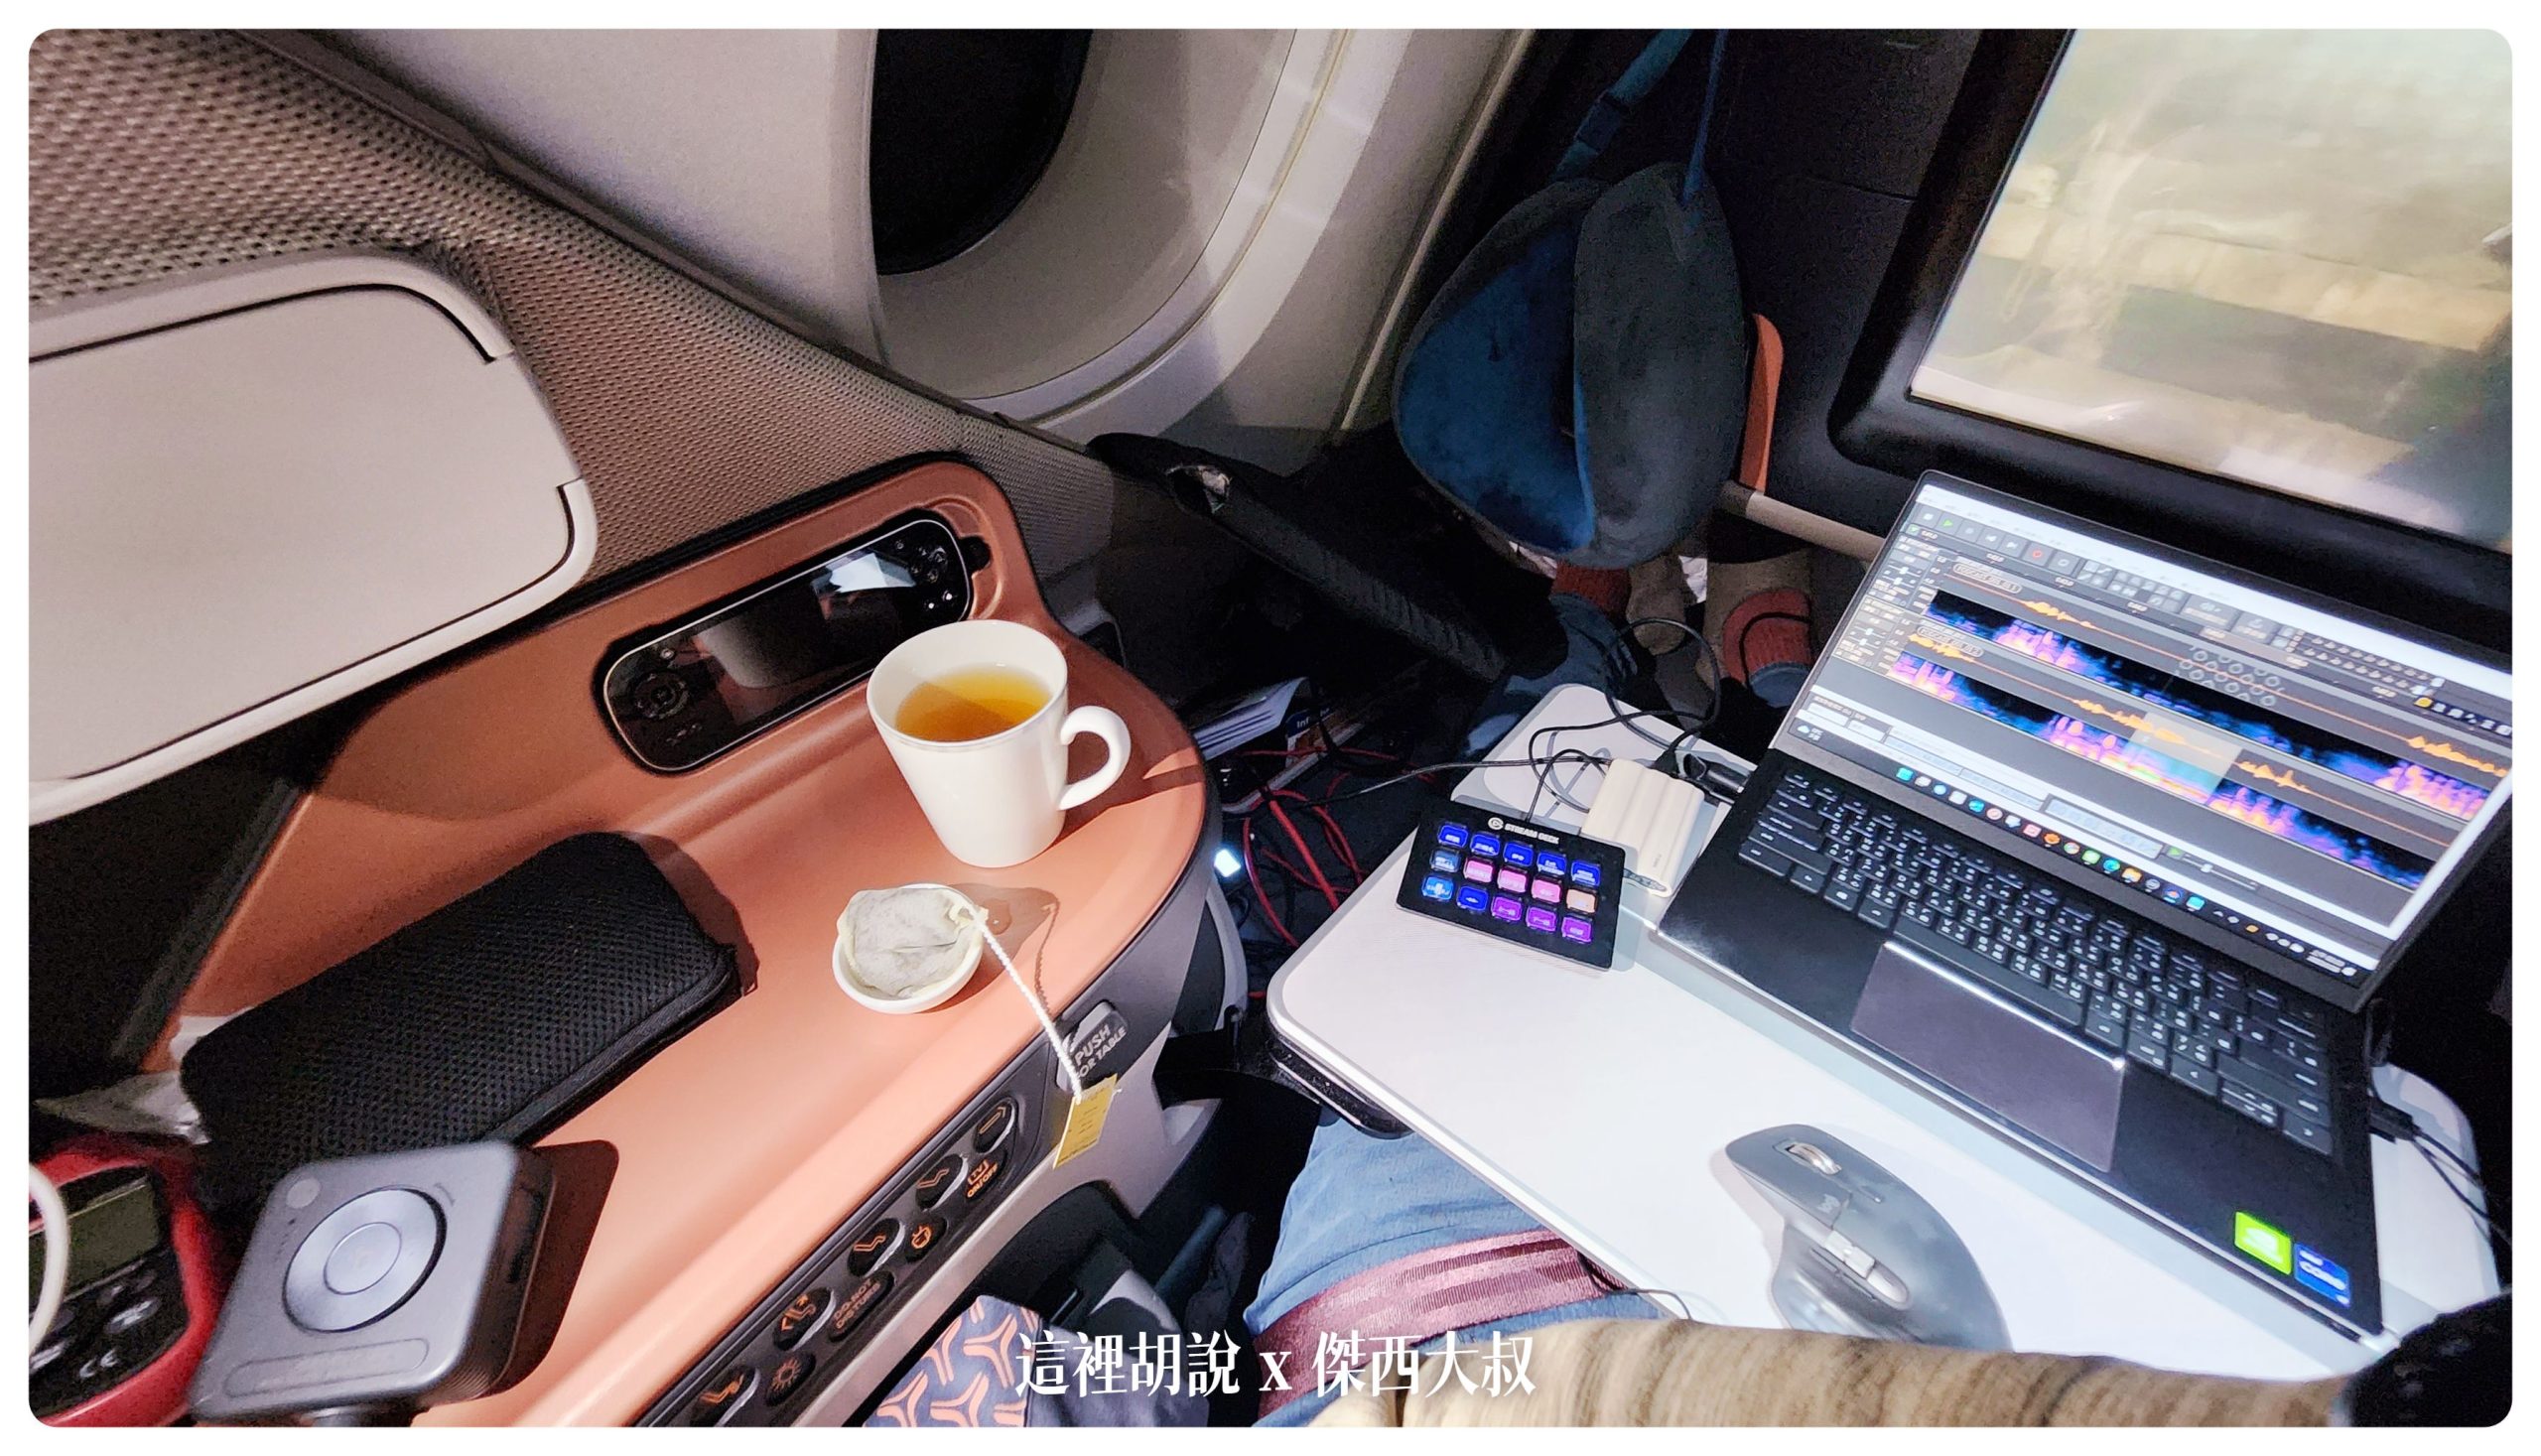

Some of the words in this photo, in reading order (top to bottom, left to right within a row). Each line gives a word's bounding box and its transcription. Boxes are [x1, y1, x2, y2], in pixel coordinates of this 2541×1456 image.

[1504, 823, 1538, 839] STREAM
[1074, 1023, 1111, 1066] PUSH
[1076, 1058, 1097, 1078] OR
[1095, 1026, 1128, 1061] TABLE
[967, 1161, 998, 1198] ON/OFF
[836, 1282, 881, 1329] DISTURB
[851, 1277, 872, 1302] NOT
